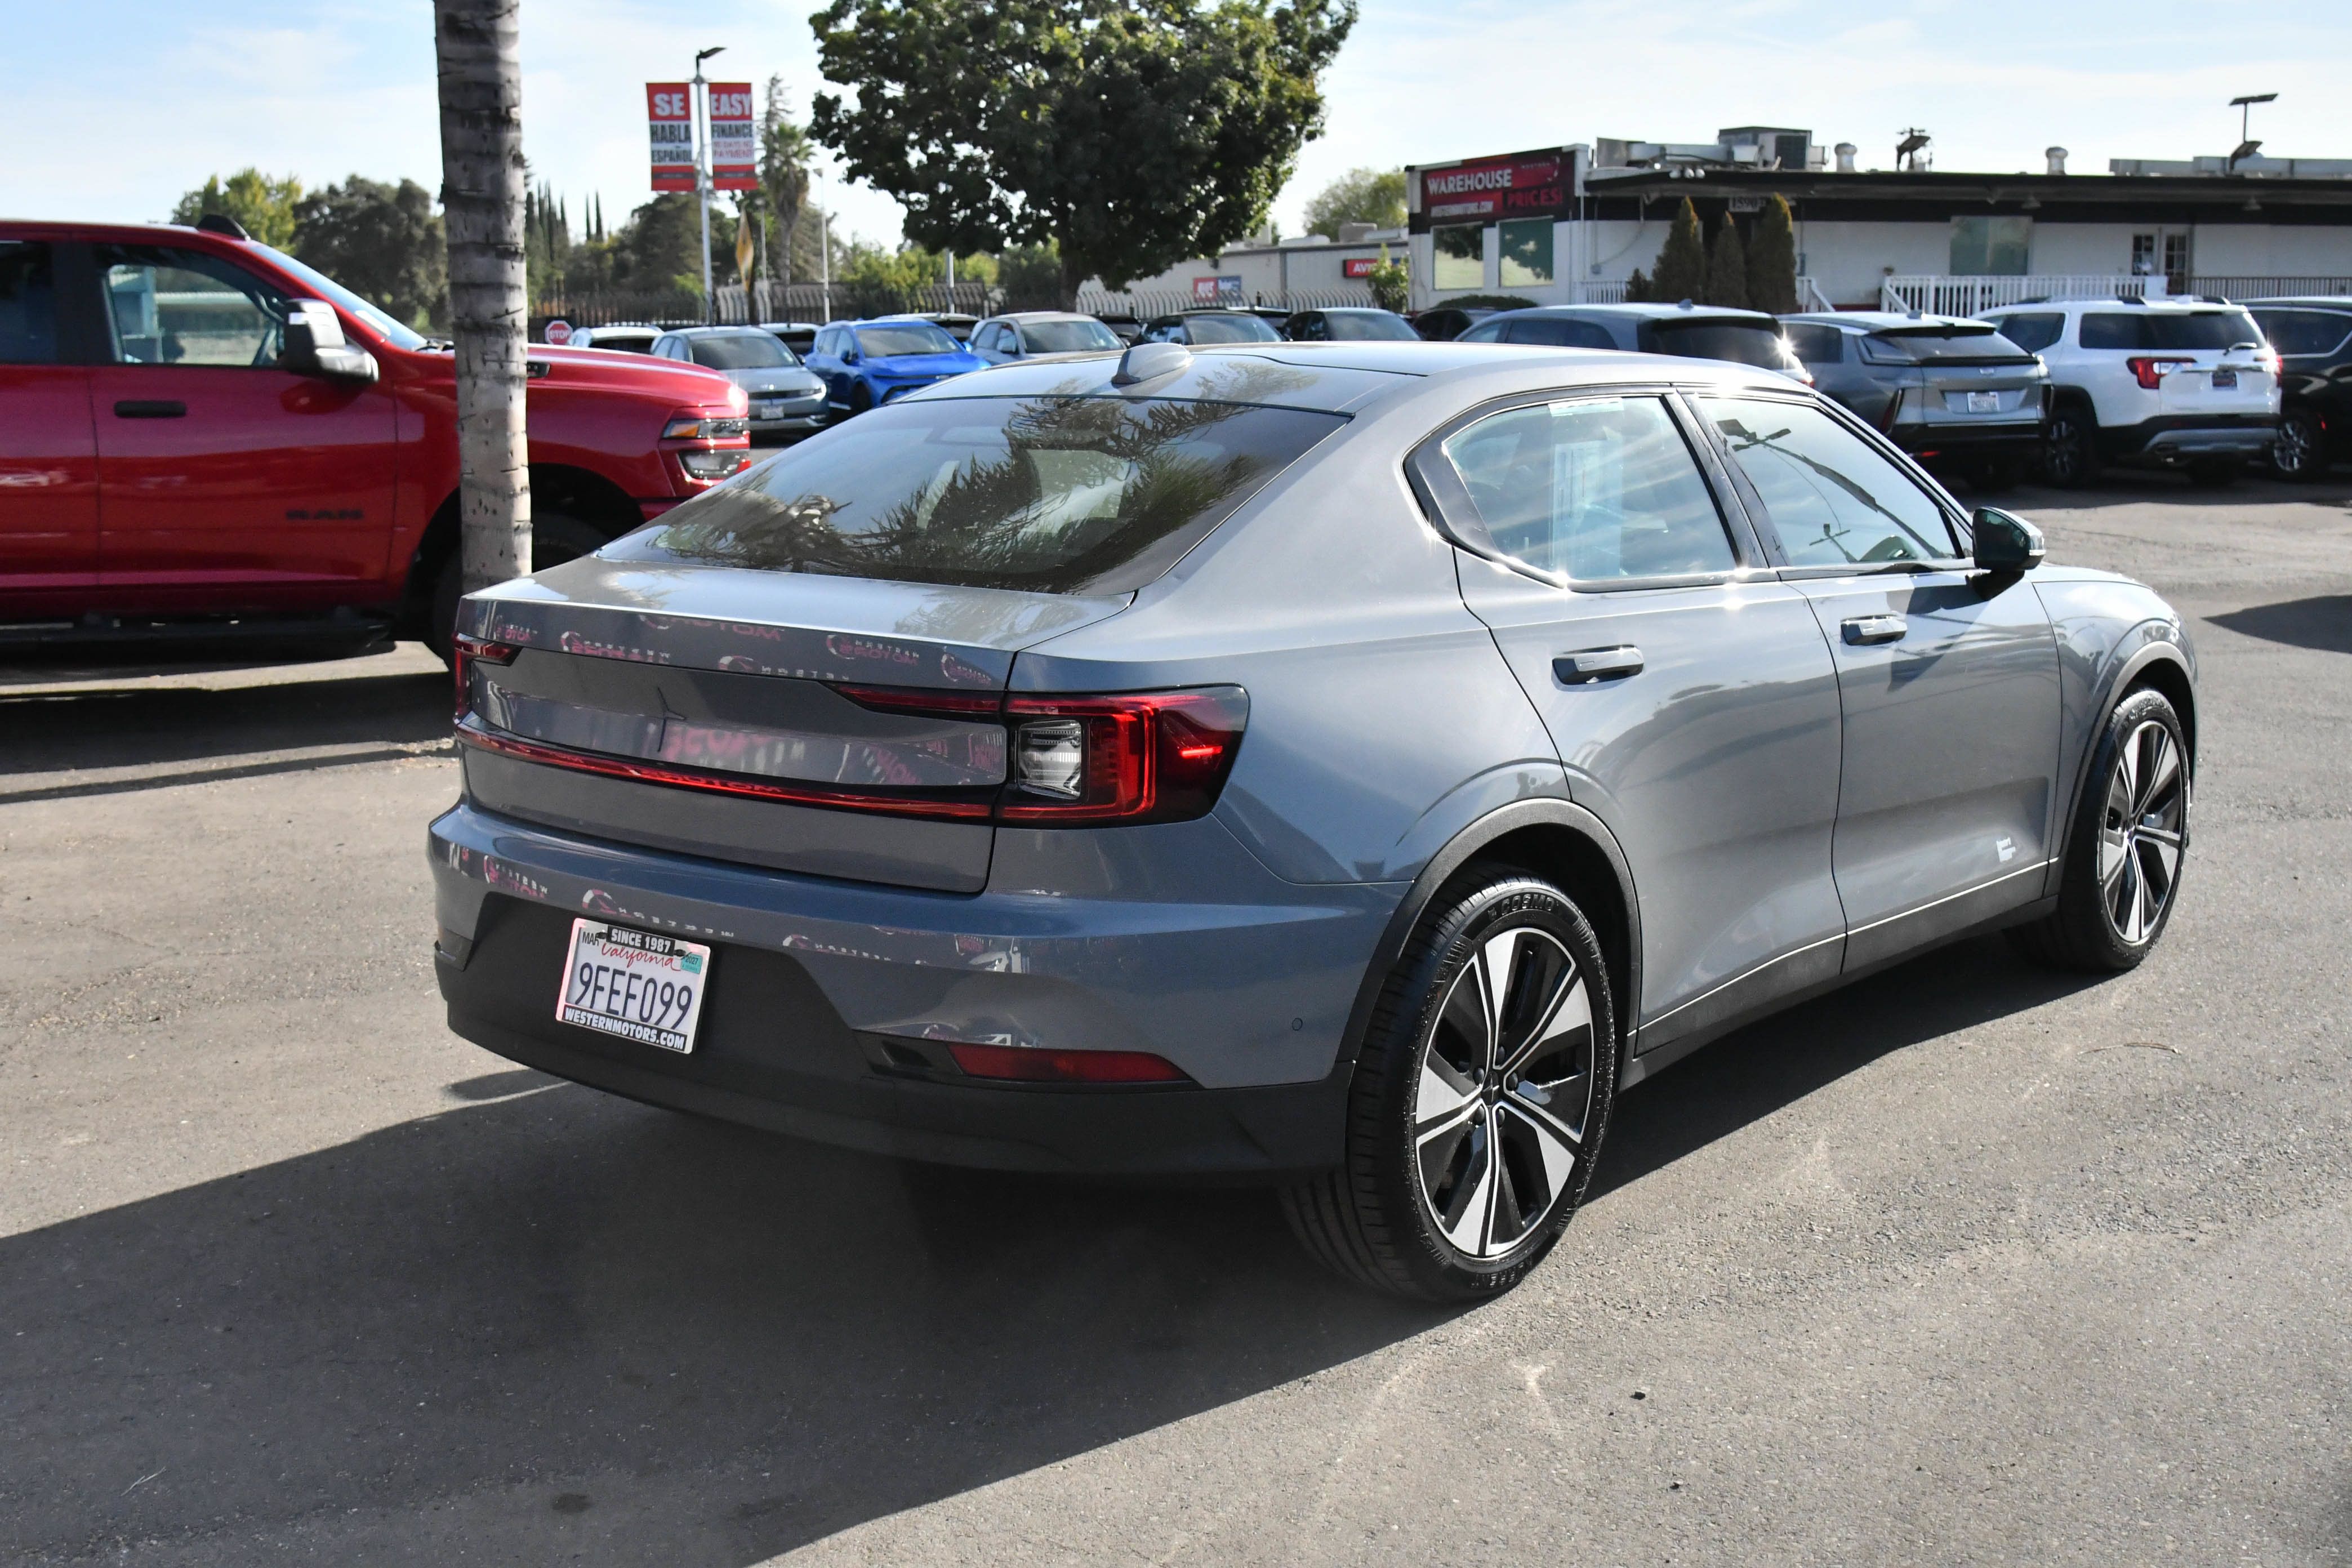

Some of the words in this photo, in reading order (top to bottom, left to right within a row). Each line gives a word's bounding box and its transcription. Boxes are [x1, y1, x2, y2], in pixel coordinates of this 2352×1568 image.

[653, 93, 685, 116] SE
[711, 93, 752, 116] EASY
[651, 124, 692, 143] HABLA
[1427, 168, 1513, 195] WAREHOUSE
[549, 329, 570, 339] STOP
[1502, 894, 1554, 915] COSMO
[611, 928, 643, 946] SINCE
[644, 937, 671, 954] 1987
[601, 943, 681, 972] California
[685, 956, 698, 965] 2027
[574, 962, 693, 1030] 9FEF099
[564, 1006, 685, 1050] WESTERNMOTORS.COM
